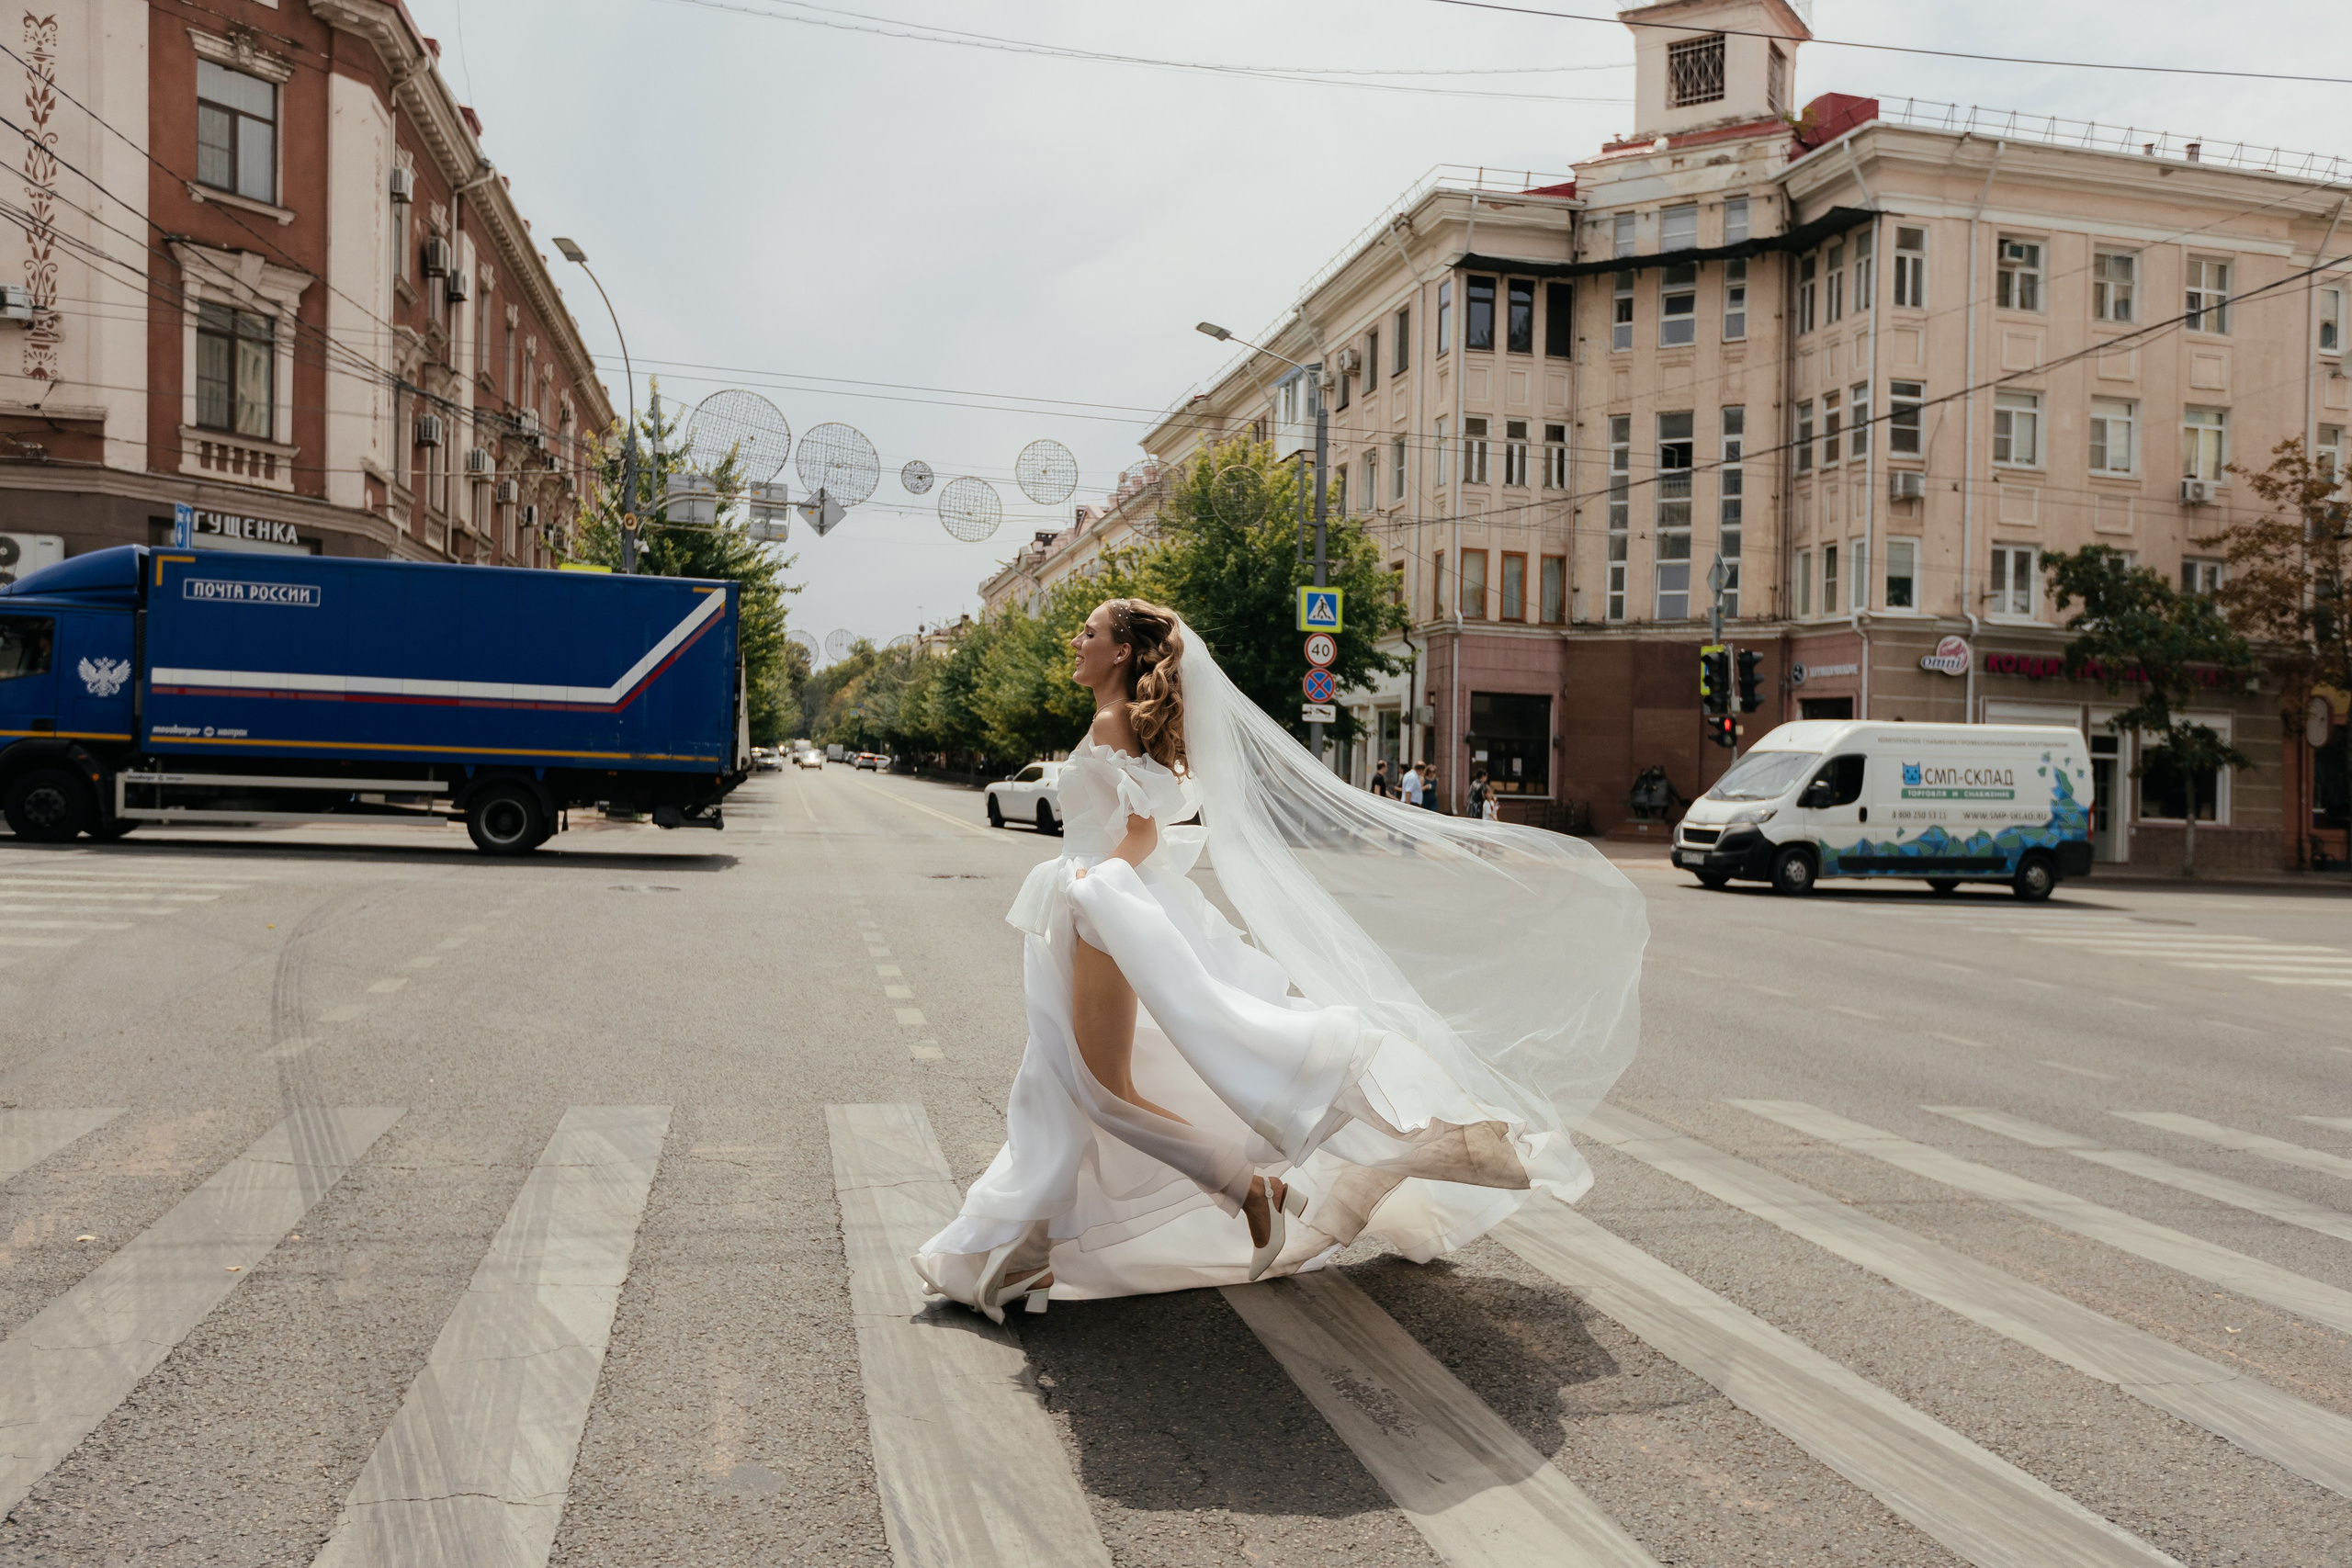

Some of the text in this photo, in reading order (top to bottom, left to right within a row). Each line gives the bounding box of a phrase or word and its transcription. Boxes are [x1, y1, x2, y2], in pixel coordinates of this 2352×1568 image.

[193, 511, 299, 545] ГУЩЕНКА
[194, 581, 311, 603] ПОЧТА РОССИИ
[1311, 643, 1330, 657] 40
[1922, 656, 1962, 670] omni
[1924, 767, 2014, 786] СМП-СКЛАД
[1907, 789, 1947, 797] ТОРГОВЛЯ
[1963, 790, 2010, 798] СНАБЖЕНИЕ
